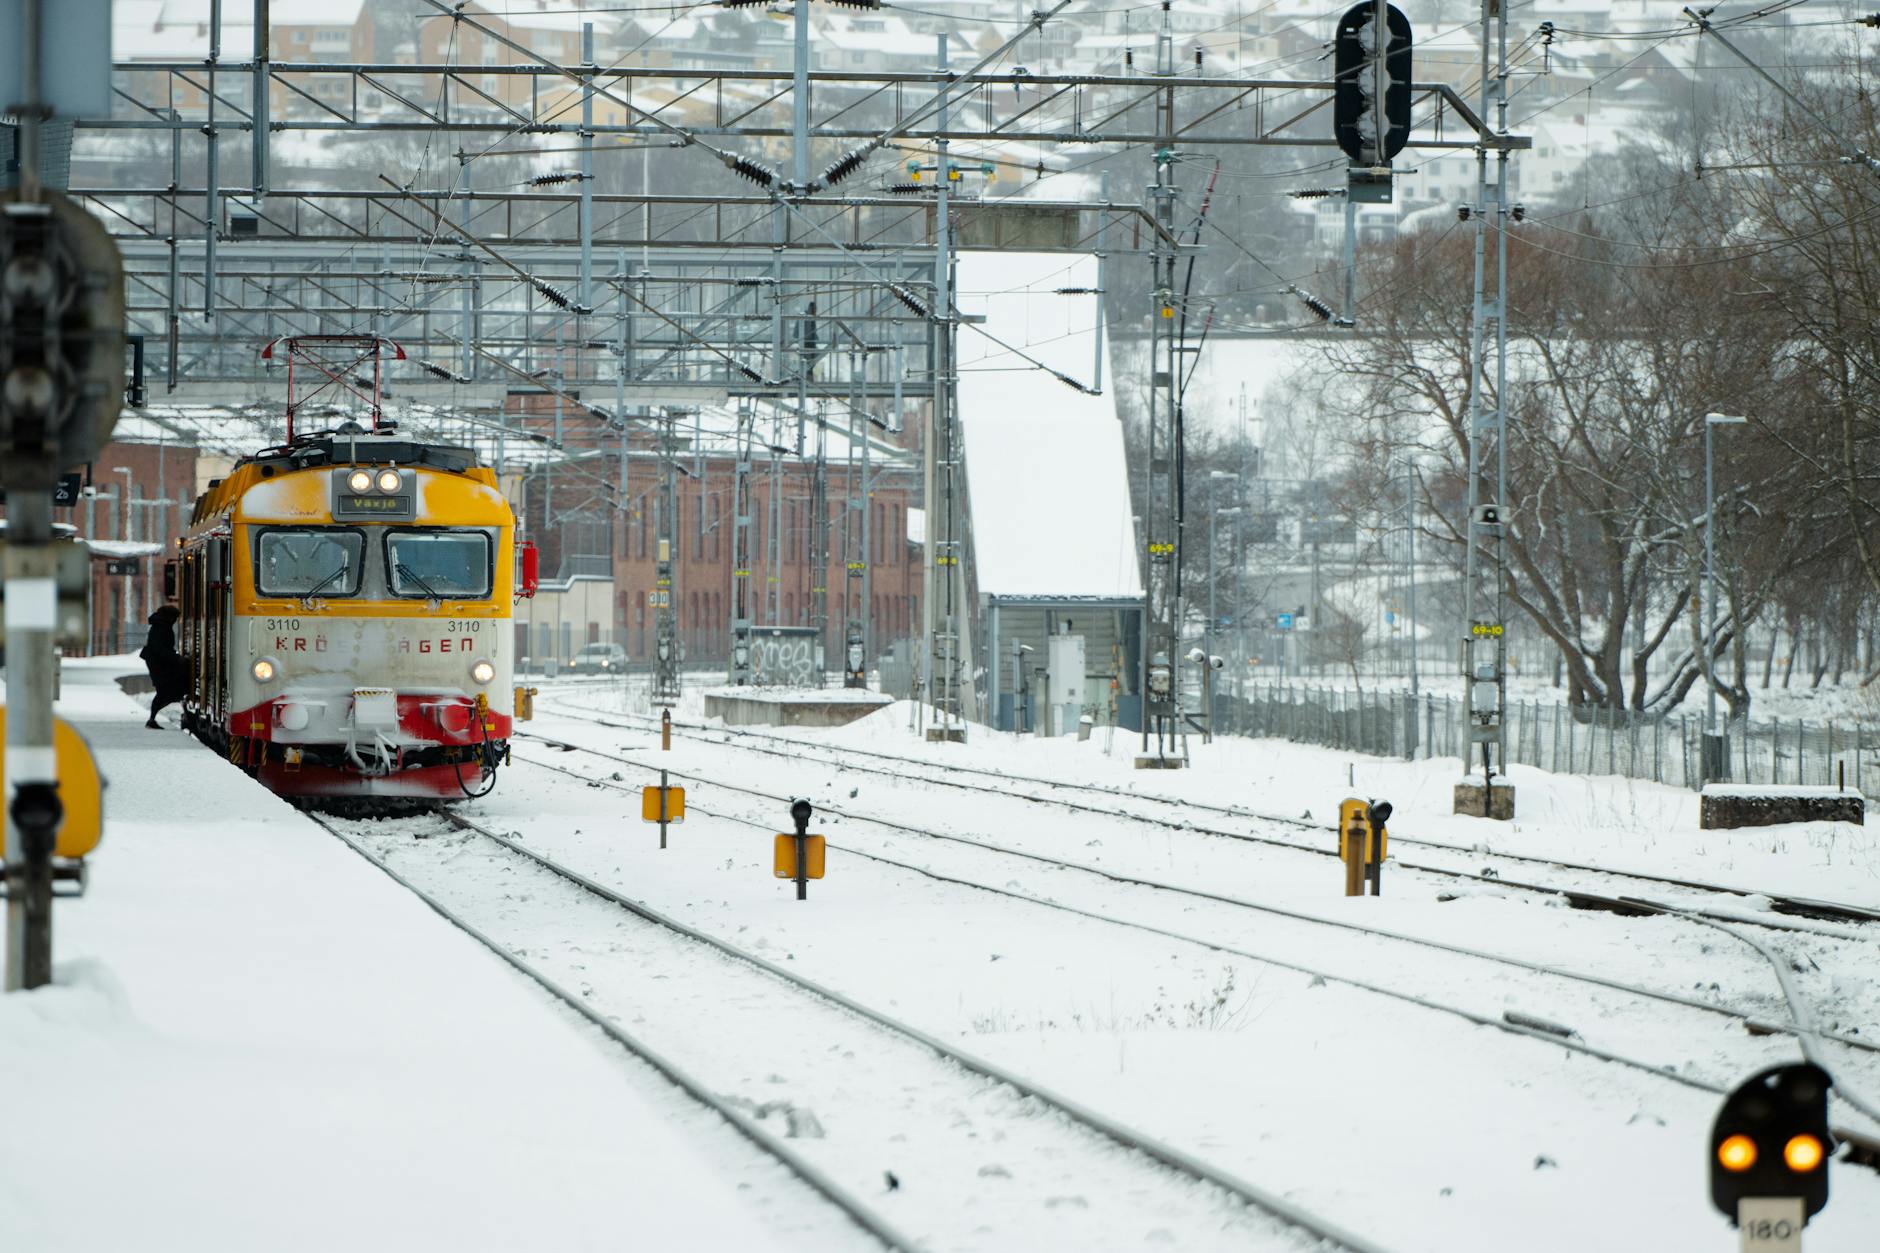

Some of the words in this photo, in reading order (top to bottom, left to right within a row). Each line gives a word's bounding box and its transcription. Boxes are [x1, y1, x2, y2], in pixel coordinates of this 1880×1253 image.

[1150, 543, 1174, 553] 69-9
[937, 557, 957, 566] 698
[267, 619, 300, 631] 3110
[448, 621, 480, 632] 3110
[1472, 625, 1503, 635] 69-10
[276, 634, 473, 653] KRÖÅGEN
[1748, 1219, 1792, 1241] 180
